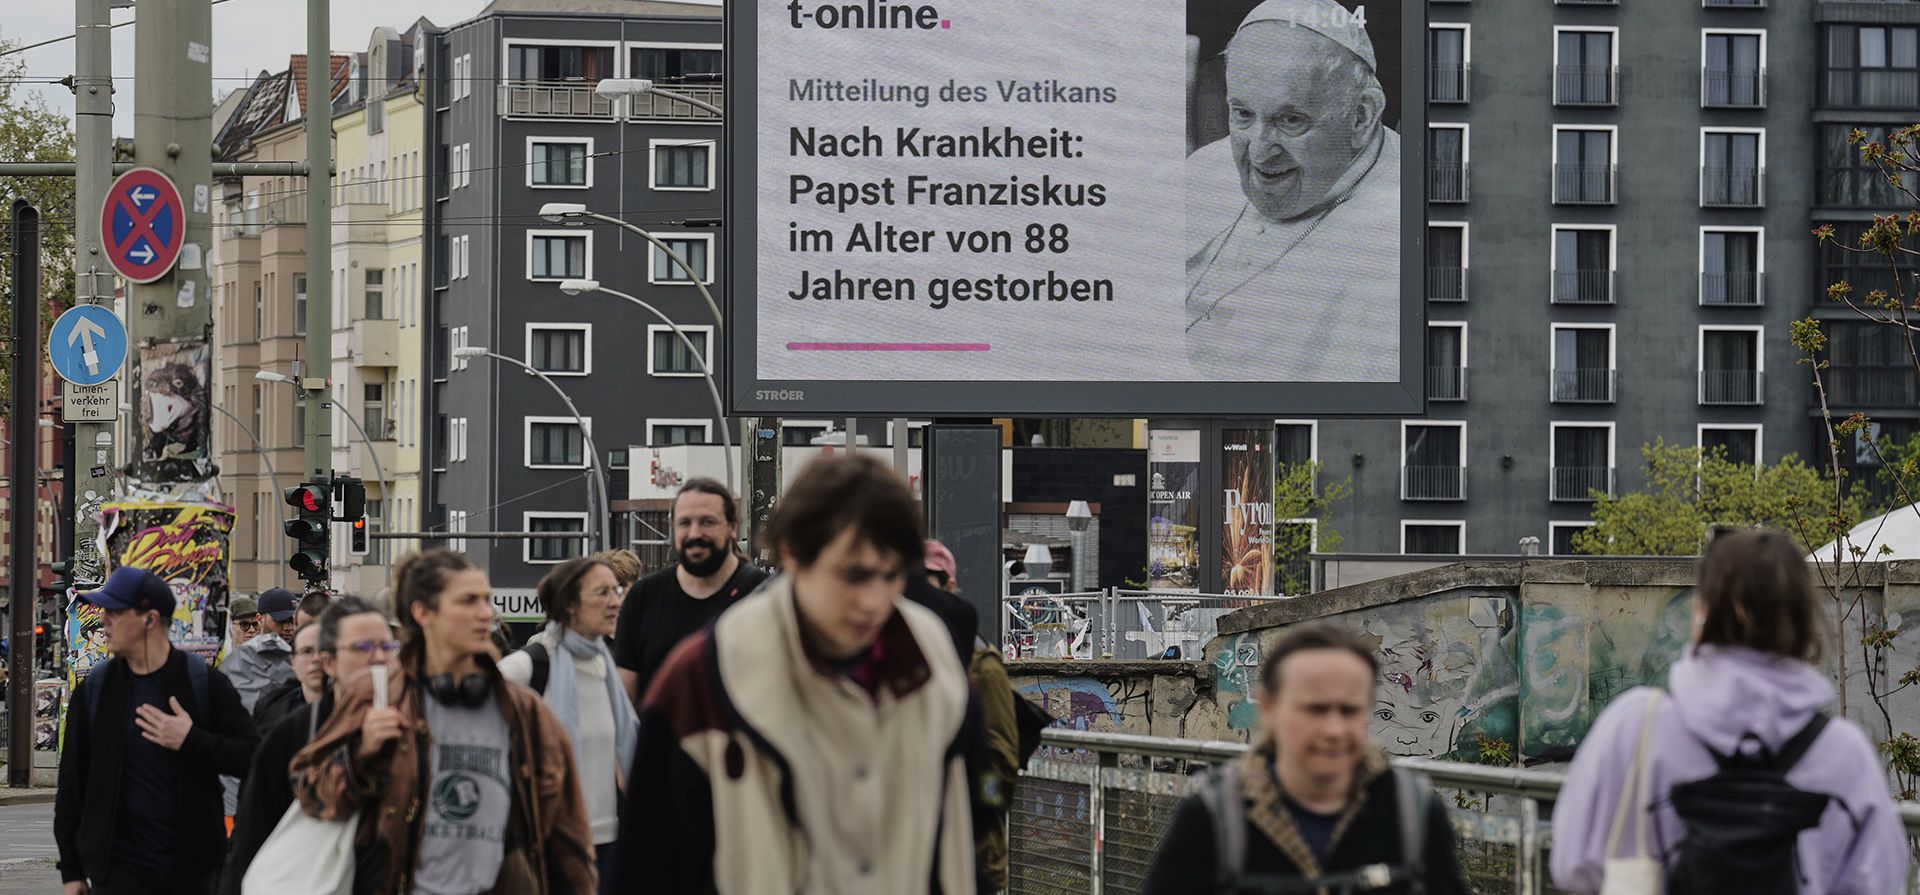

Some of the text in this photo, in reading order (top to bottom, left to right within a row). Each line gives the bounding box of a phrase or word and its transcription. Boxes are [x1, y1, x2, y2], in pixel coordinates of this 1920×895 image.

[787, 0, 950, 30] t-online.
[1284, 6, 1367, 28] 14:04
[789, 79, 1117, 108] Mitteilung des Vatikans
[790, 126, 1083, 158] Nach Krankheit:
[790, 174, 1106, 213] Papst Franziskus
[789, 220, 1070, 253] im Alter von 88
[788, 270, 1113, 309] Jahren gestorben
[70, 396, 110, 406] verkehr
[73, 384, 108, 394] Linien-
[755, 389, 805, 400] STRÖER
[82, 407, 99, 417] frei
[1156, 490, 1175, 500] OPEN
[1176, 491, 1192, 500] AIR
